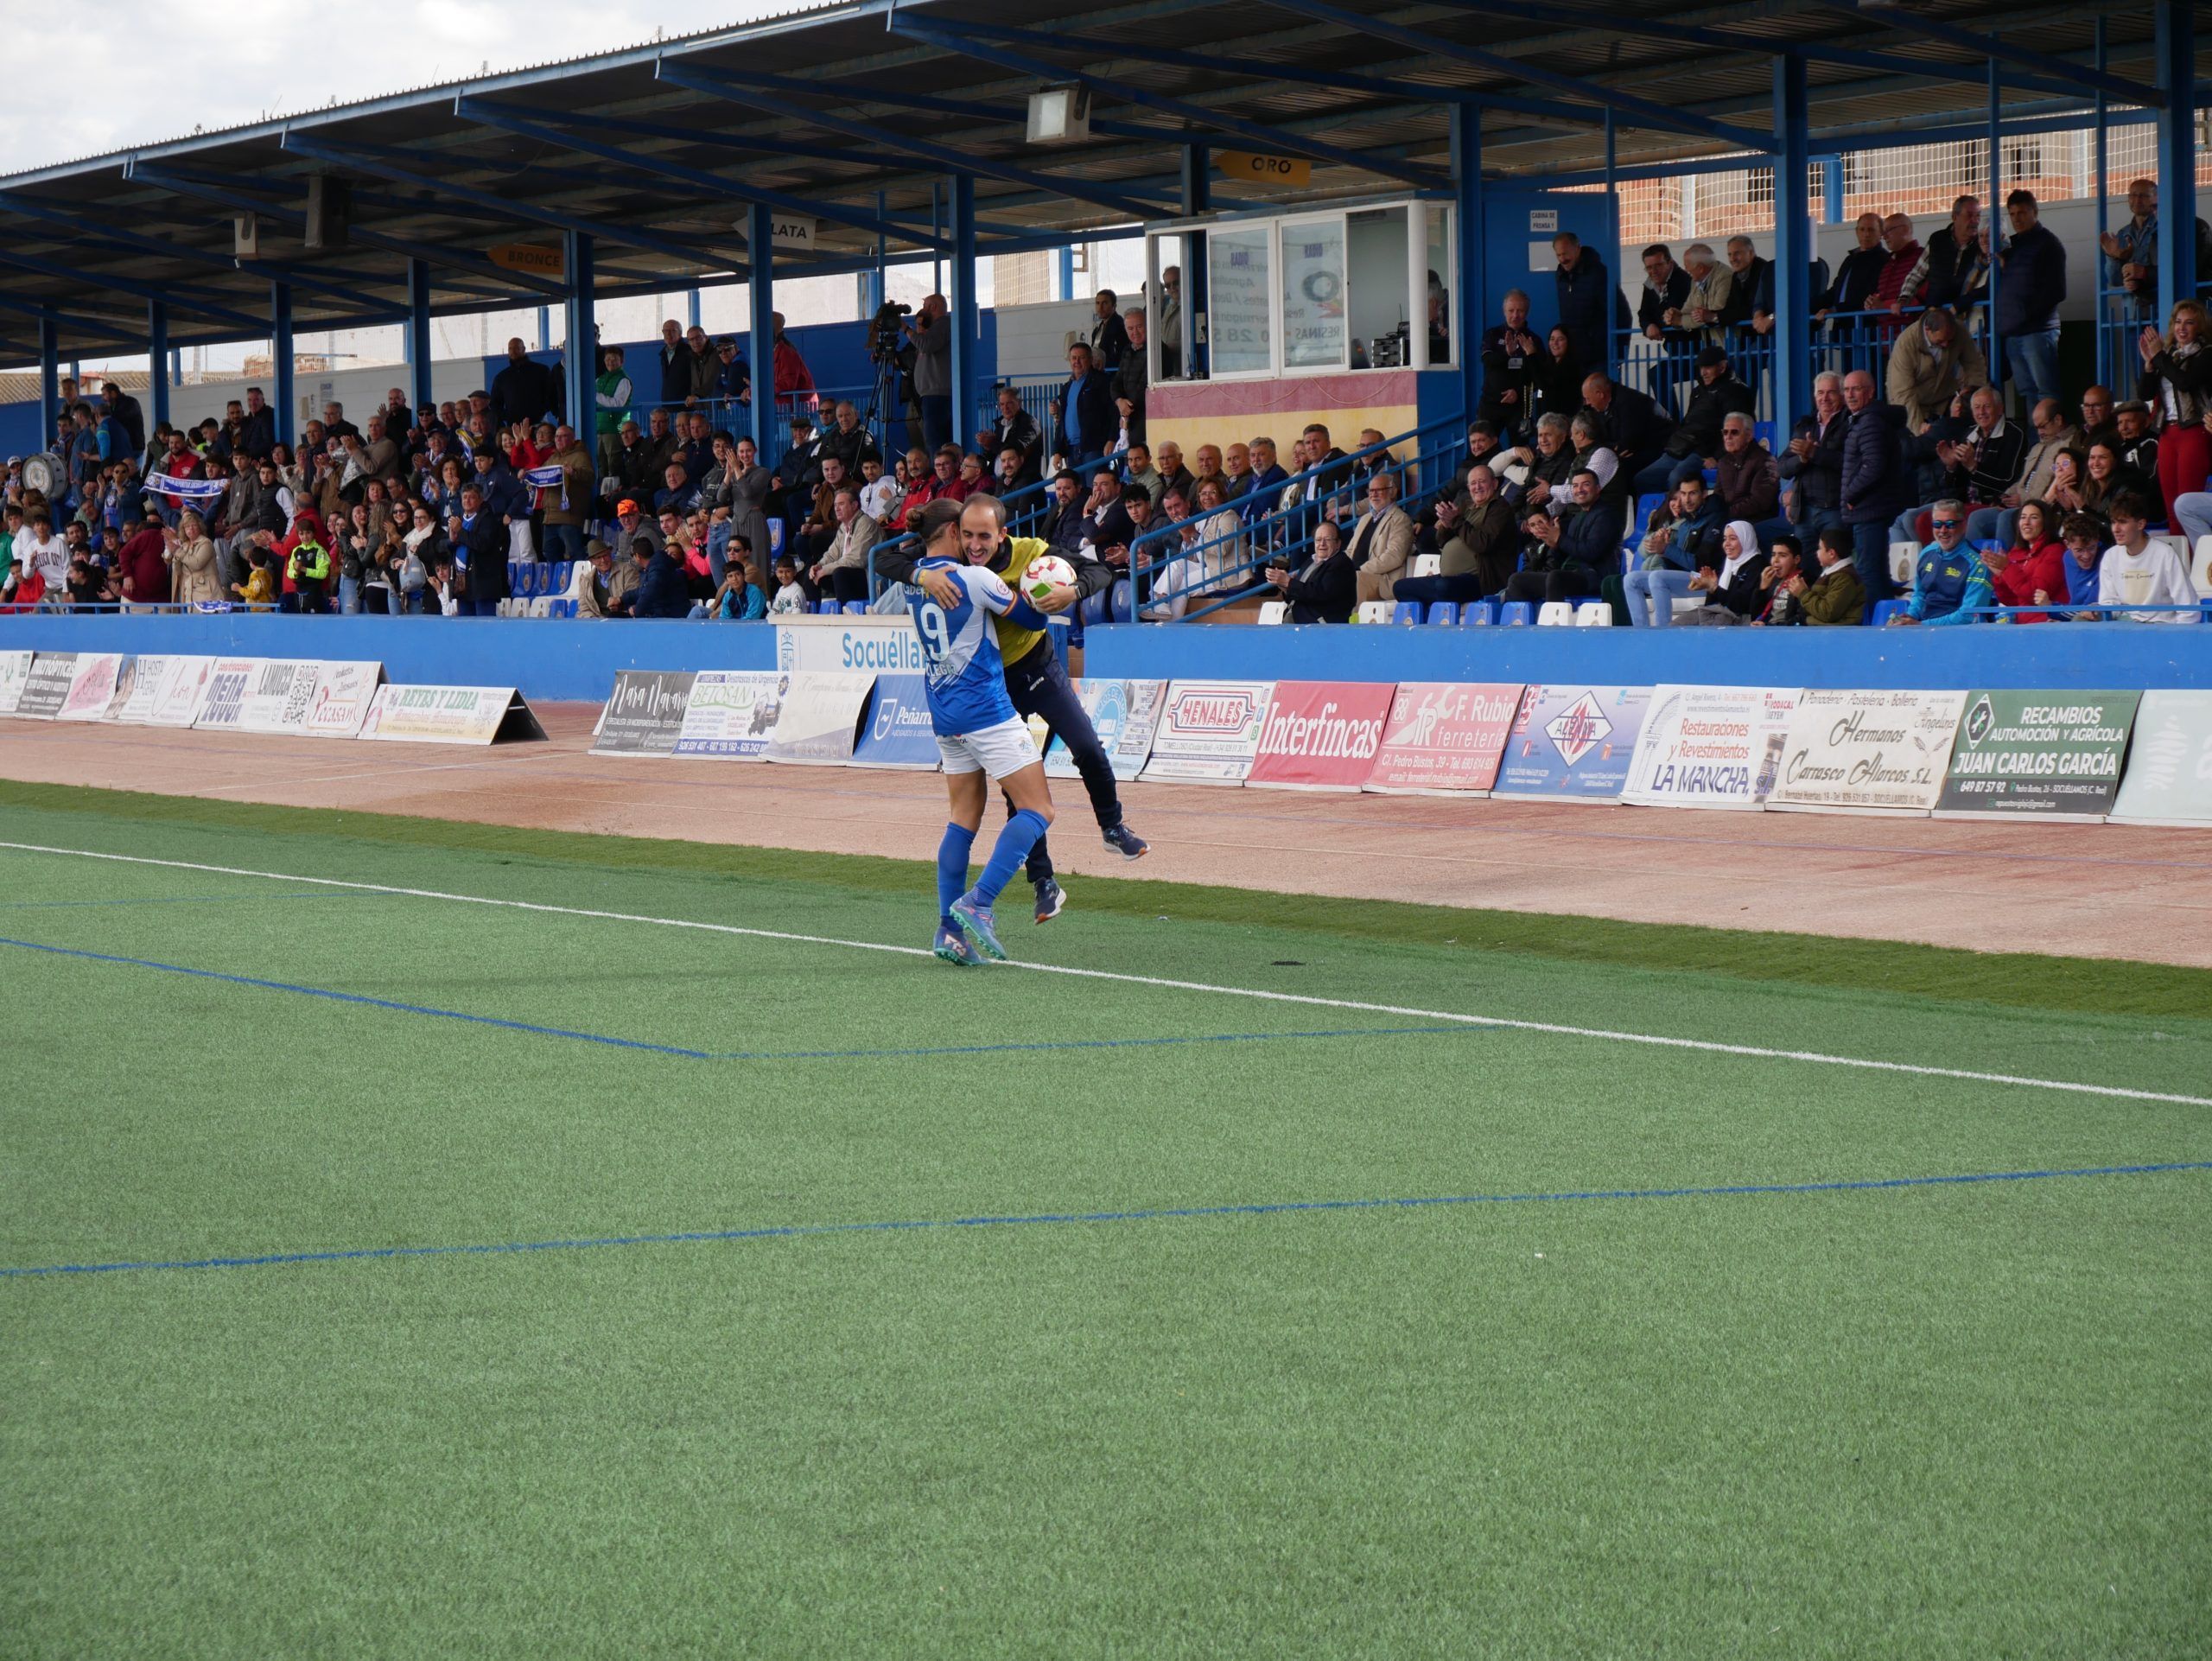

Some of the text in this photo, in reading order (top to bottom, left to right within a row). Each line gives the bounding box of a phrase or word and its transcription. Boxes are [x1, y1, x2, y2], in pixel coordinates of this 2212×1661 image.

[1251, 156, 1292, 174] ORO
[771, 222, 807, 239] LATA
[507, 251, 561, 268] BRONCE
[842, 631, 928, 670] Socuélla
[398, 689, 438, 708] REYES
[443, 691, 479, 710] LIDIA
[692, 685, 751, 704] BETOSAN
[1179, 699, 1243, 727] HENALES
[1455, 694, 1468, 721] F.
[1471, 694, 1516, 723] Rubio
[2021, 706, 2103, 725] RECAMBIOS
[1258, 700, 1382, 760] Interfincas
[1681, 717, 1749, 737] Restauraciones
[1829, 710, 1907, 748] Hermanos
[1989, 724, 2124, 741] AUTOMOCIÓN Y AGRÍCOLA
[1393, 754, 1413, 767] Pedro
[1667, 740, 1751, 761] y Revestimientos
[1787, 748, 1847, 786] Carrasco
[1954, 748, 2117, 776] JUAN CARLOS GARCÍA
[1651, 764, 1675, 792] LA
[1677, 766, 1750, 797] MANCHA,
[1960, 780, 2006, 793] 649 87 57 92
